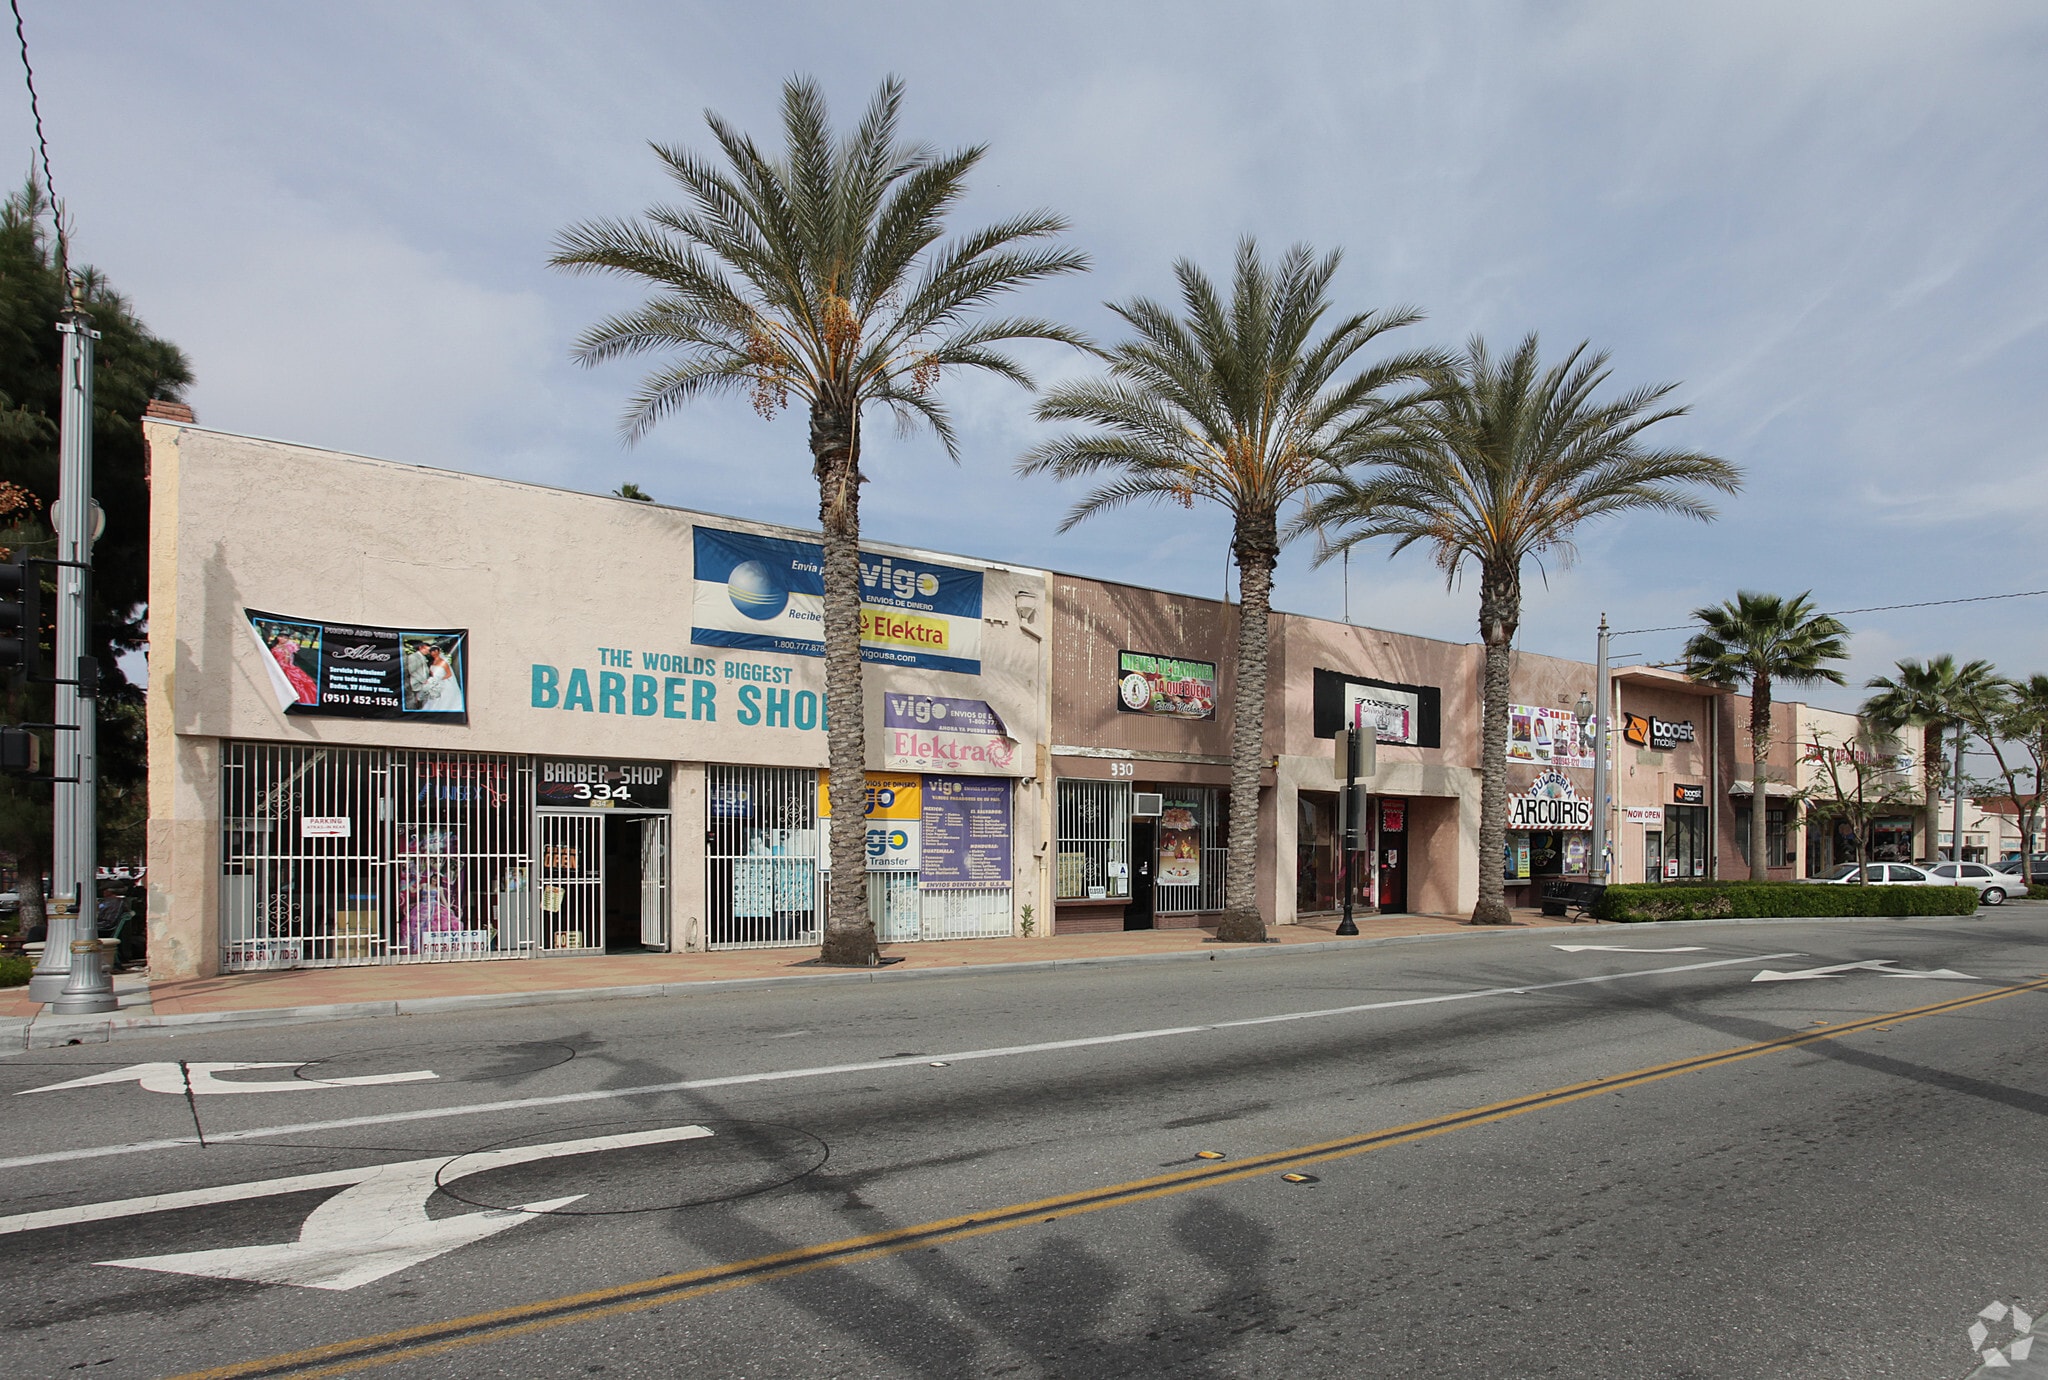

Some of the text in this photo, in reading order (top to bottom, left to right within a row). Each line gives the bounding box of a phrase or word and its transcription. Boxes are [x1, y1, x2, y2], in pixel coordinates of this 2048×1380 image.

[792, 560, 817, 573] Envía
[859, 558, 939, 599] vigo
[866, 595, 894, 605] ENVIOS
[907, 601, 934, 611] DINERO
[788, 610, 821, 622] Recibe
[324, 627, 353, 636] PHOTO
[874, 616, 943, 644] Elektra
[774, 640, 826, 652] 1.800.777.878
[598, 648, 792, 684] THE WORLDS BIGGEST
[1122, 653, 1214, 681] NIEVES DE GARRAFA
[531, 664, 716, 722] BARBER
[1154, 678, 1211, 698] LA QUE BUENA
[323, 693, 398, 706] (951) 452-1556
[892, 696, 946, 723] vigo
[951, 710, 976, 718] ENVIOS
[1653, 717, 1693, 740] boost
[894, 732, 986, 761] Elektra
[1654, 738, 1676, 748] mobile
[544, 762, 663, 785] BARBER SHOP
[1112, 763, 1133, 776] 330
[573, 783, 632, 800] 334
[929, 779, 962, 795] vigo
[1532, 774, 1573, 799] DULCERIA
[1684, 788, 1701, 797] boost
[864, 788, 895, 814] go
[1512, 799, 1588, 824] ARCOIRIS
[866, 829, 908, 856] go
[544, 853, 577, 869] OPEN
[870, 857, 908, 866] Transfer
